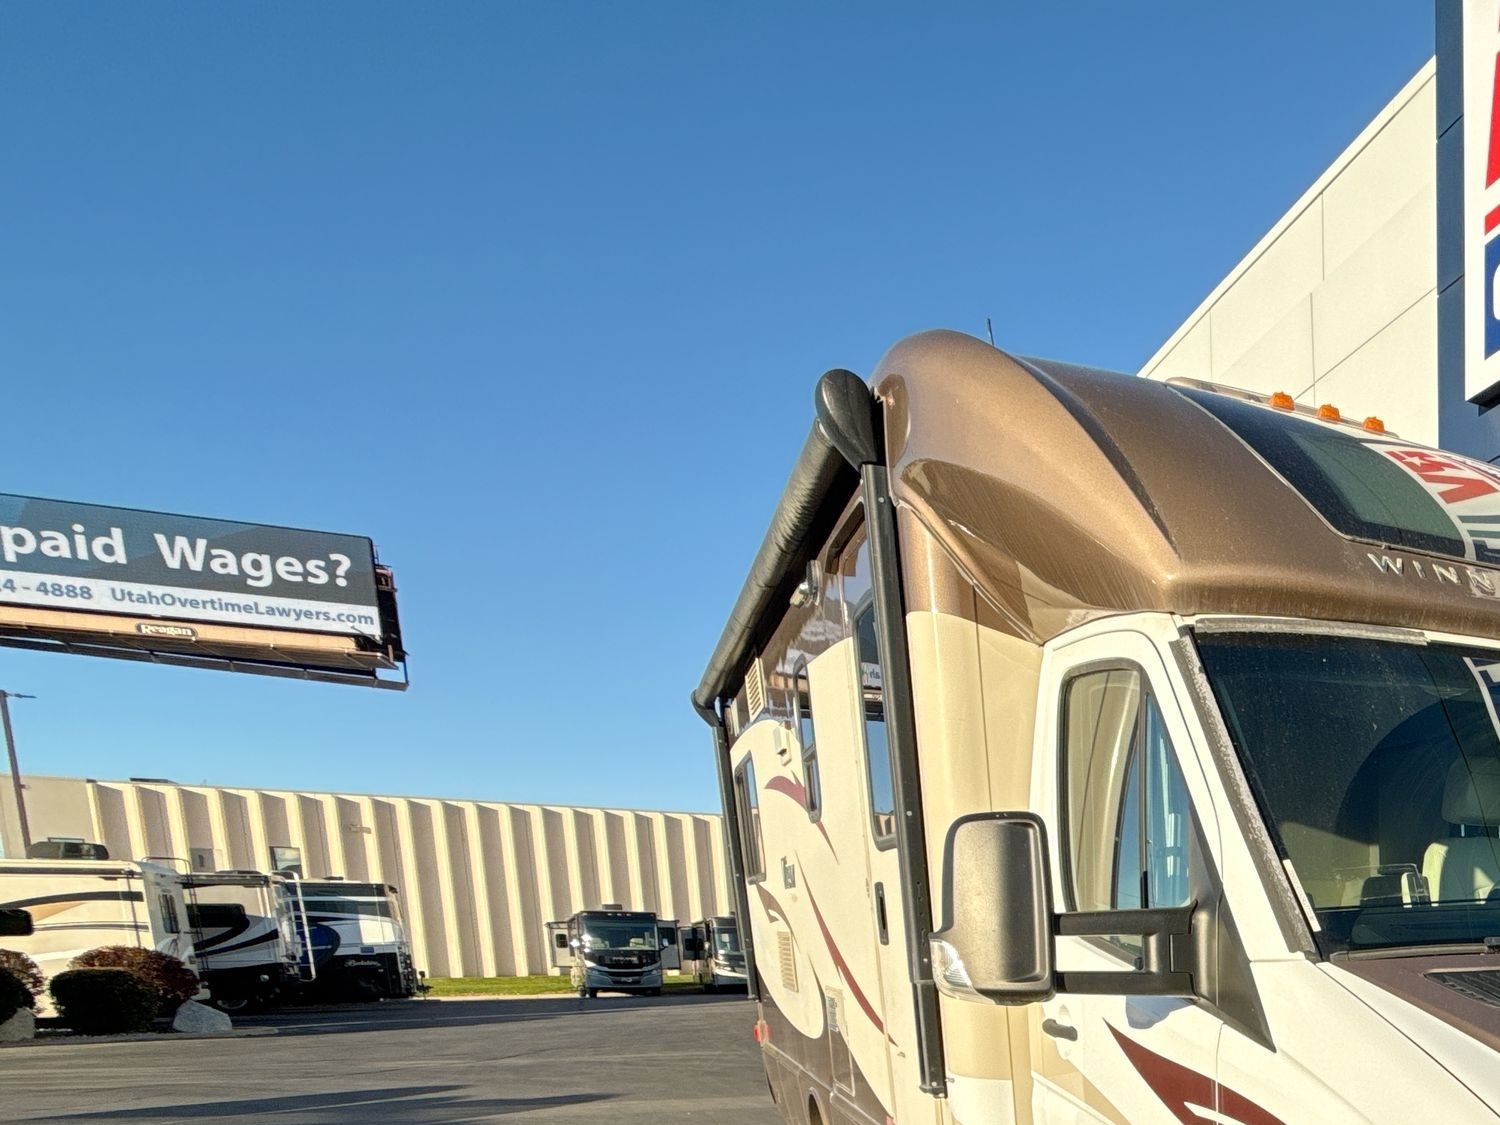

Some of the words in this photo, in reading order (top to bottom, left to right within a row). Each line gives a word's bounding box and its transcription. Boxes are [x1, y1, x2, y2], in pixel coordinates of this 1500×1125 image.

[0, 523, 127, 564] paid
[153, 532, 352, 587] Wages?
[110, 587, 375, 626] UtahOvertimeLawyers.com
[140, 624, 192, 636] Reagan
